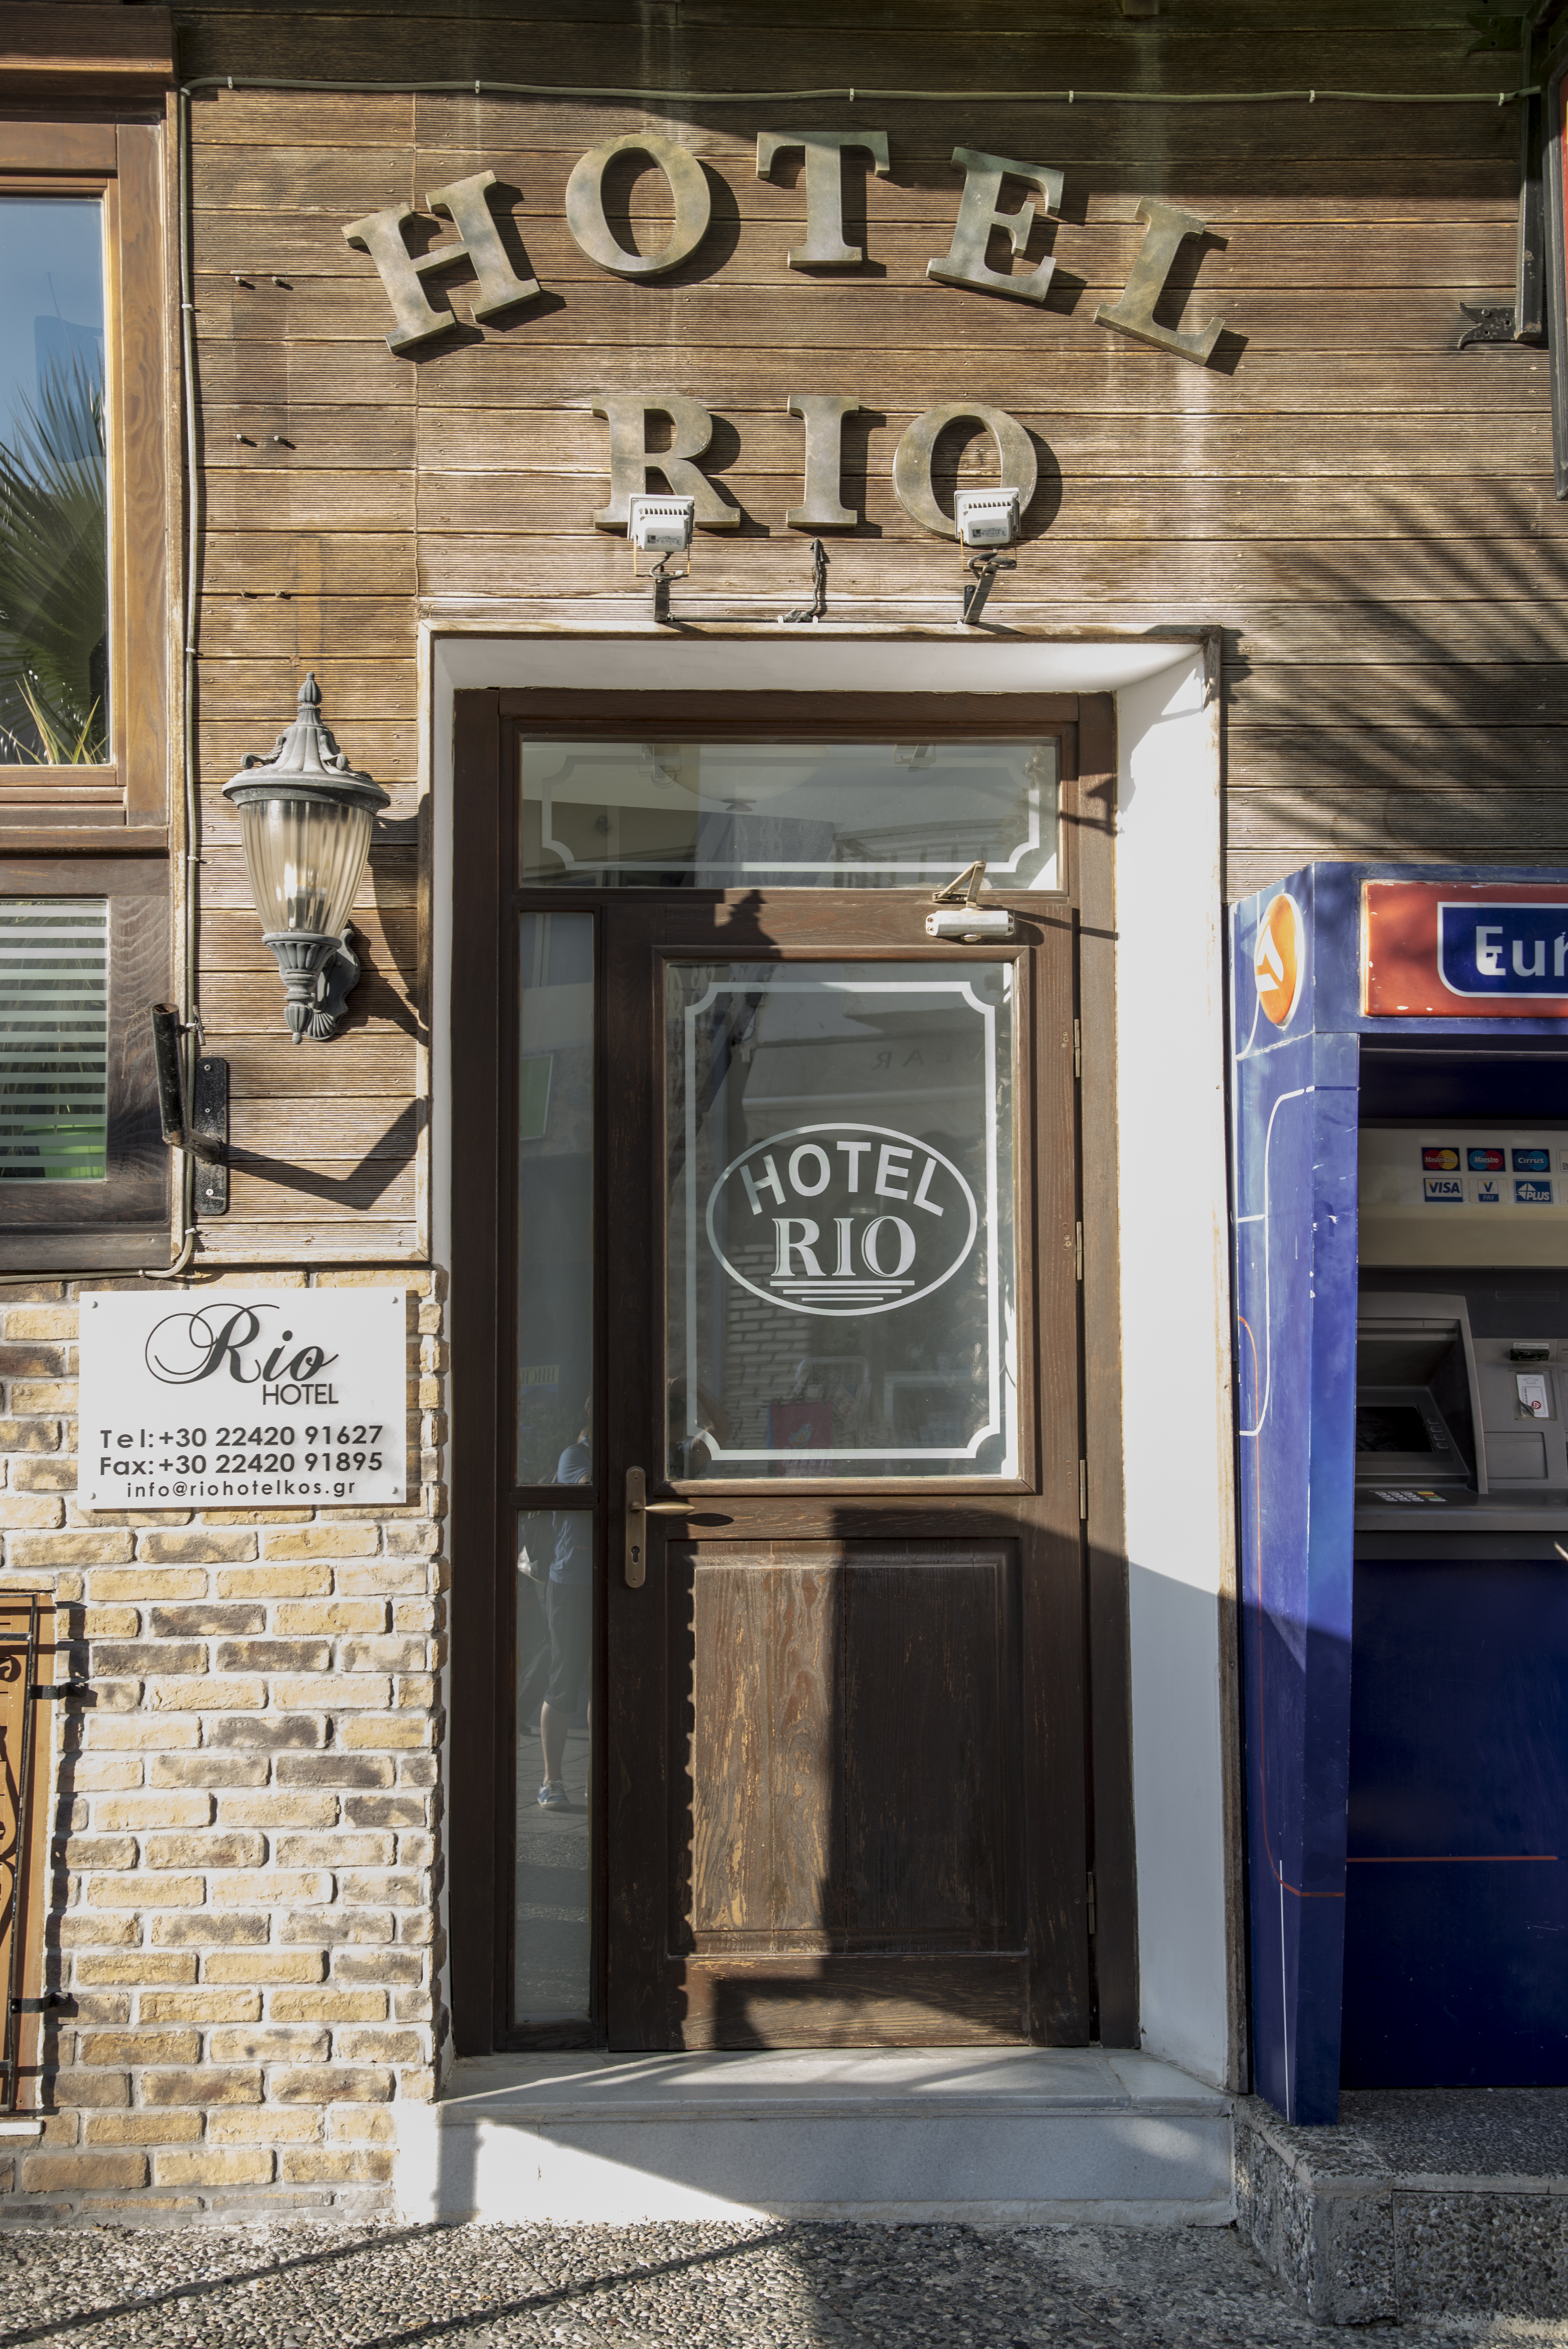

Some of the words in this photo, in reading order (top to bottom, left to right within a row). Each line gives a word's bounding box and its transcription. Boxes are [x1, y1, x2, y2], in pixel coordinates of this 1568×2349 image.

[342, 130, 1226, 366] HOTEL
[591, 395, 1037, 542] RIO
[1476, 926, 1568, 977] Eur
[739, 1141, 944, 1217] HOTEL
[1427, 1182, 1460, 1193] VISA
[1481, 1182, 1493, 1192] V
[1526, 1192, 1550, 1201] PLUS
[771, 1215, 916, 1278] RIO
[145, 1303, 339, 1384] Rio
[263, 1383, 339, 1405] HOTEL
[216, 1426, 295, 1446] 22420
[305, 1425, 383, 1445] 91627
[216, 1453, 295, 1473] 22420
[305, 1452, 382, 1472] 91895
[127, 1479, 355, 1498] info@riohotelkos.gr
